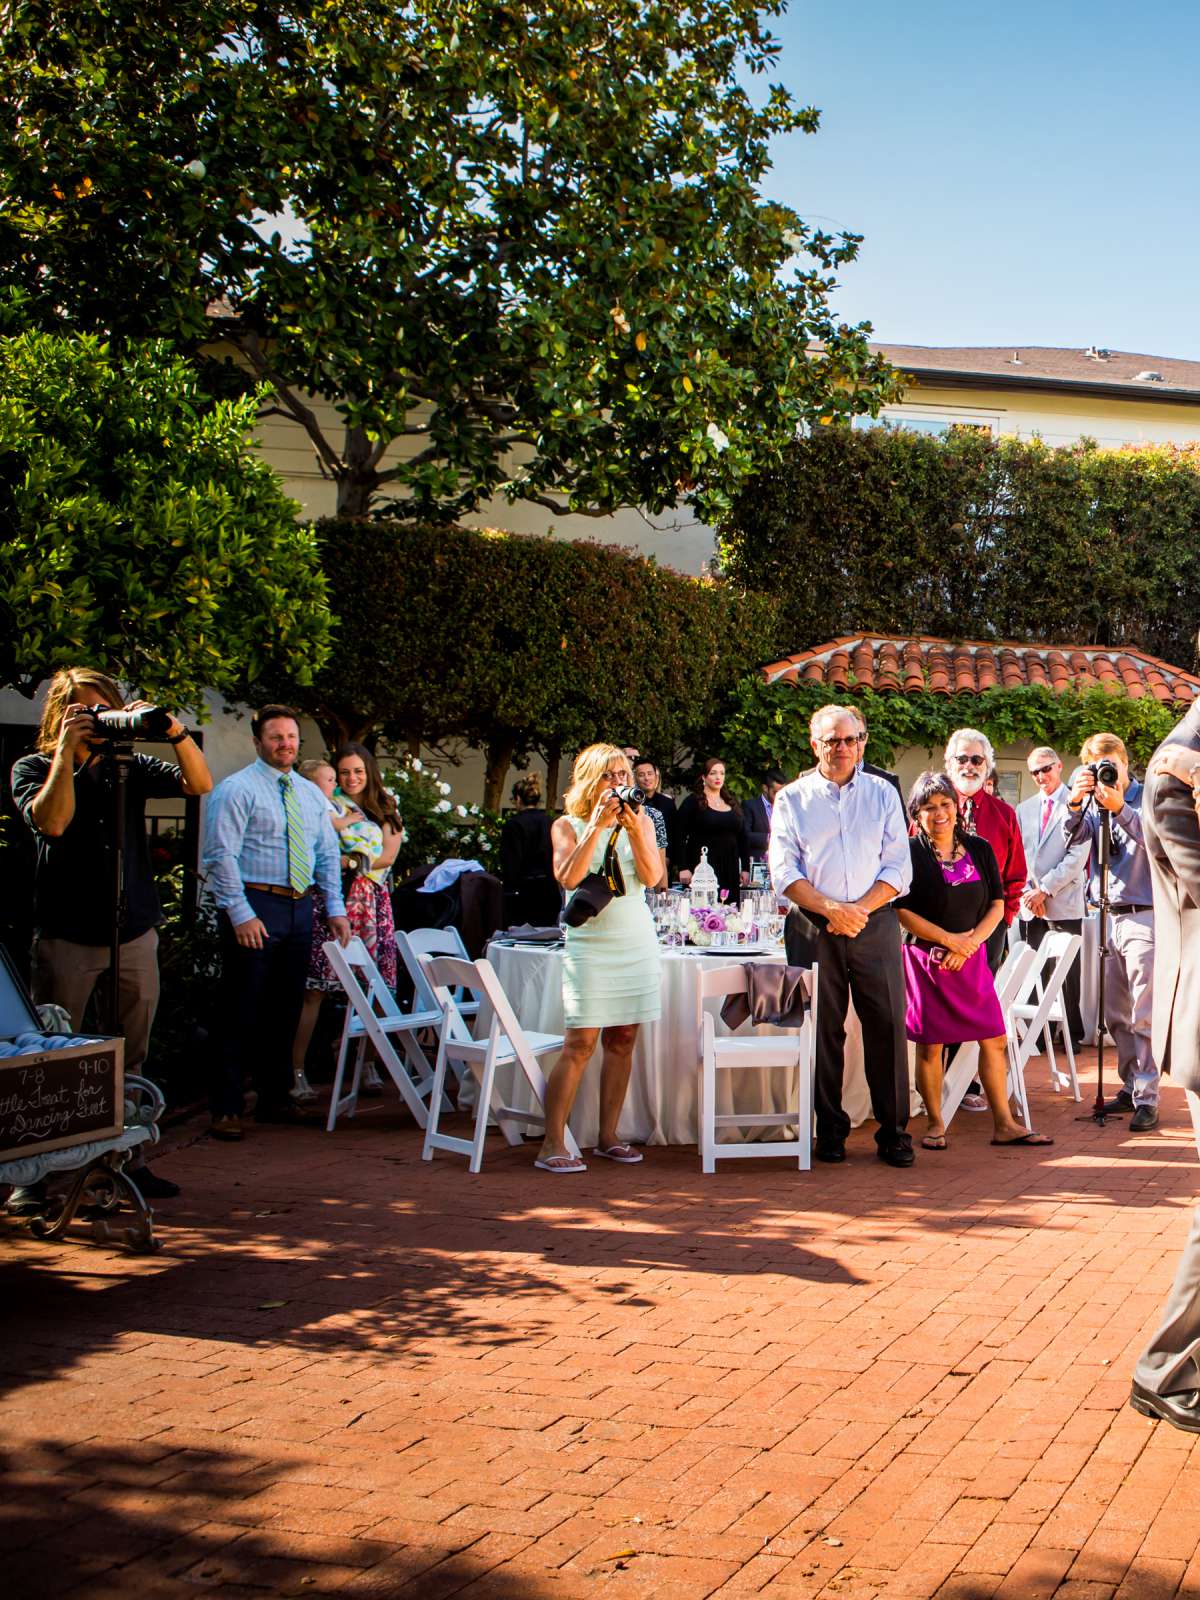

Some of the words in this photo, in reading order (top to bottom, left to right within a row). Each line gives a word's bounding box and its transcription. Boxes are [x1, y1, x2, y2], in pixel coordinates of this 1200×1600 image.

[18, 1068, 46, 1085] 7-8
[79, 1058, 111, 1075] 9-10
[73, 1078, 103, 1108] for
[9, 1109, 75, 1132] Dancing
